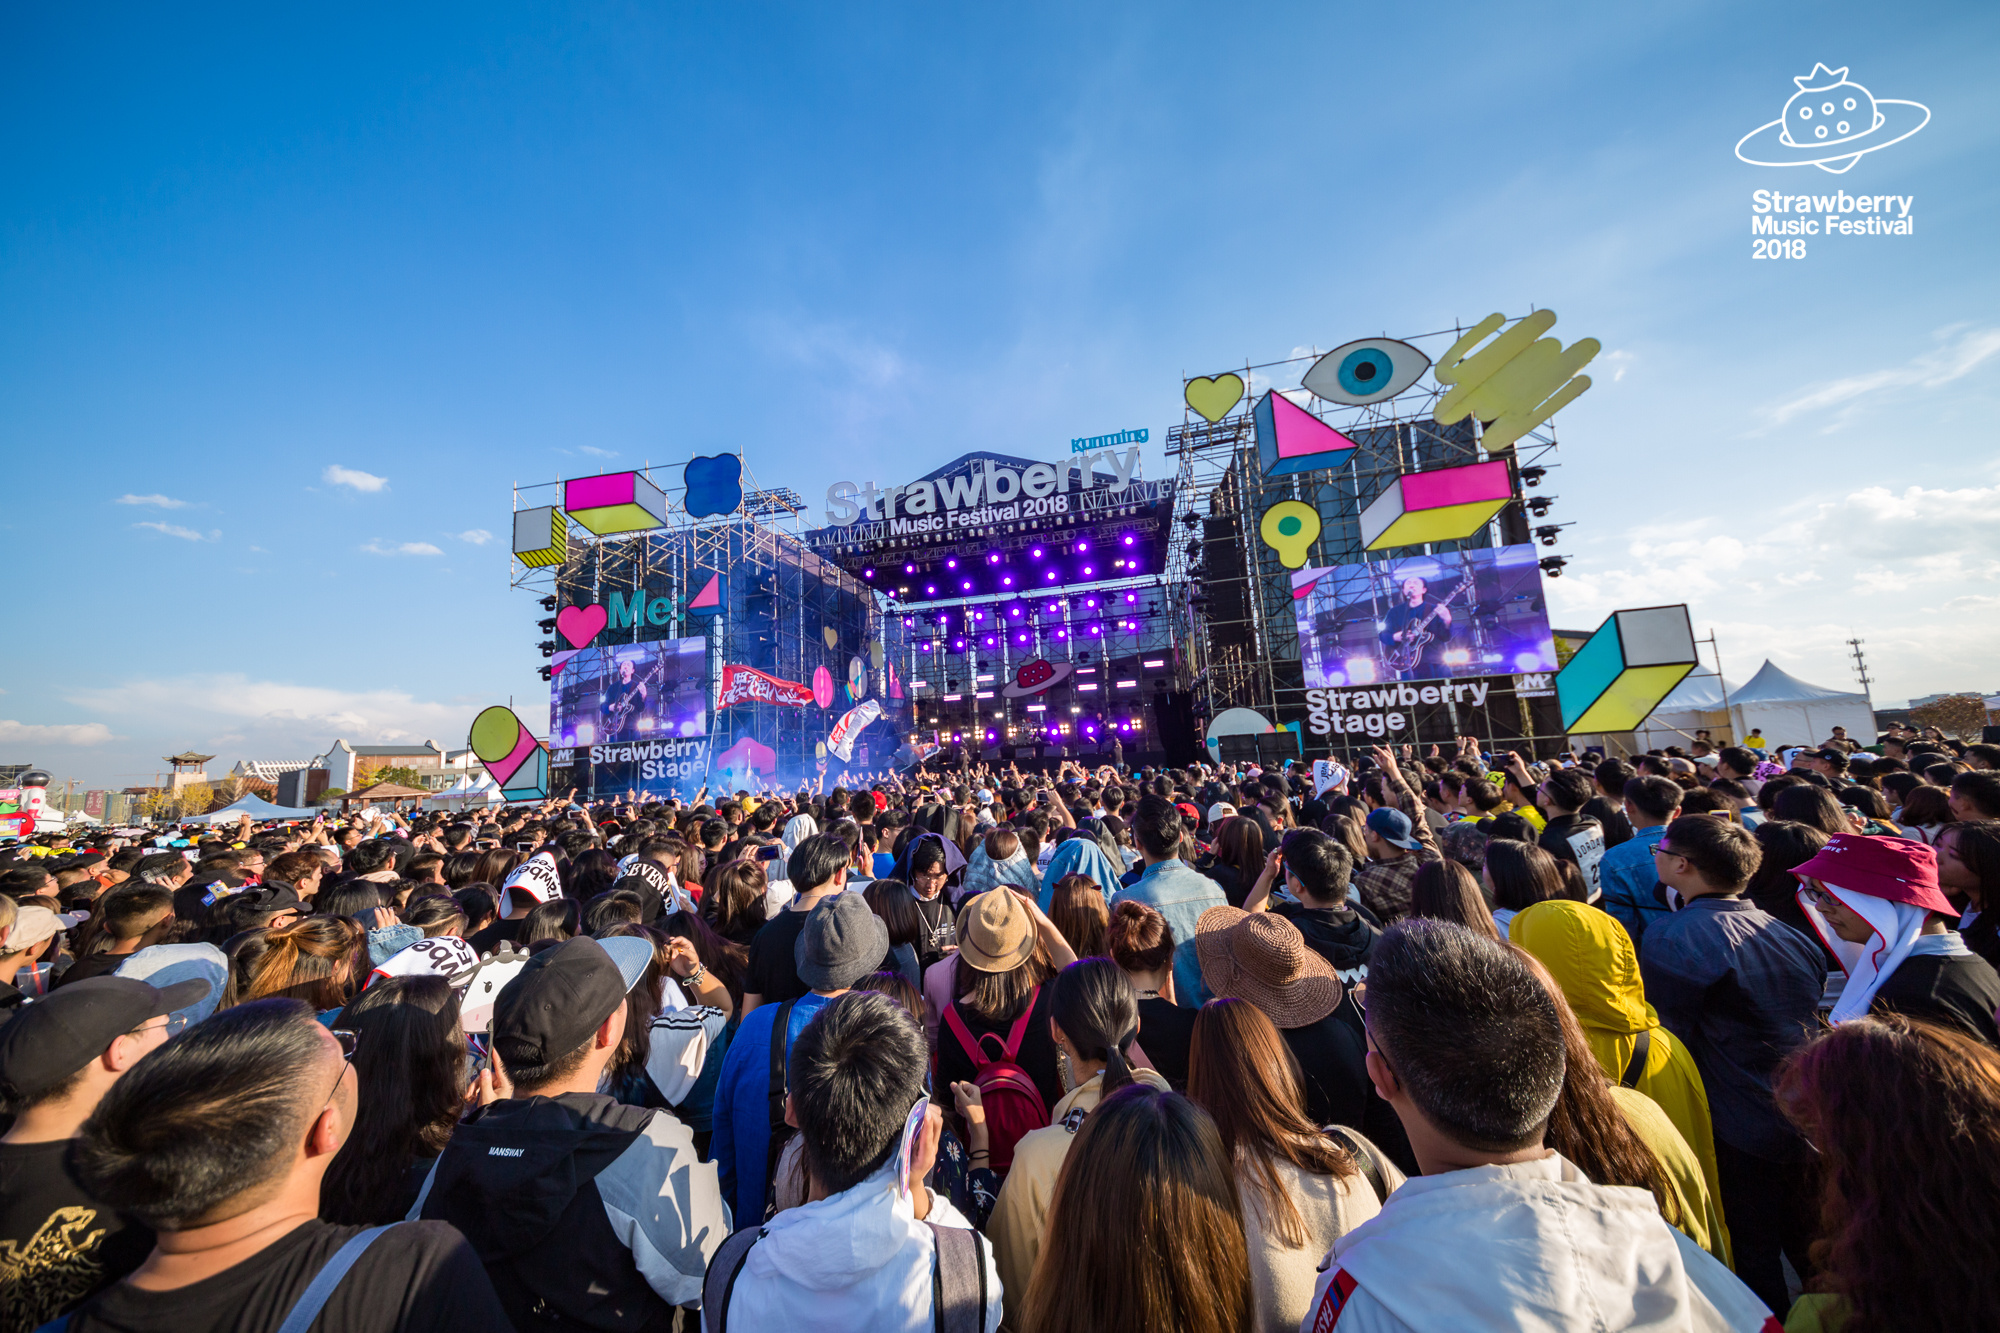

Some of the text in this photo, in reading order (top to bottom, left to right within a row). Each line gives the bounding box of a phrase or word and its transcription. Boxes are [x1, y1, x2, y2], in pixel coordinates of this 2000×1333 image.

[1071, 428, 1149, 453] Kunming
[825, 446, 1137, 527] Strawberry
[890, 494, 1069, 535] Music Festival 2018
[608, 588, 686, 629] Me:
[1305, 682, 1489, 712] Strawberry
[1308, 711, 1406, 738] Stage
[589, 740, 707, 764] Strawberry
[642, 760, 705, 780] Stage
[488, 1146, 525, 1157] MANSWAY
